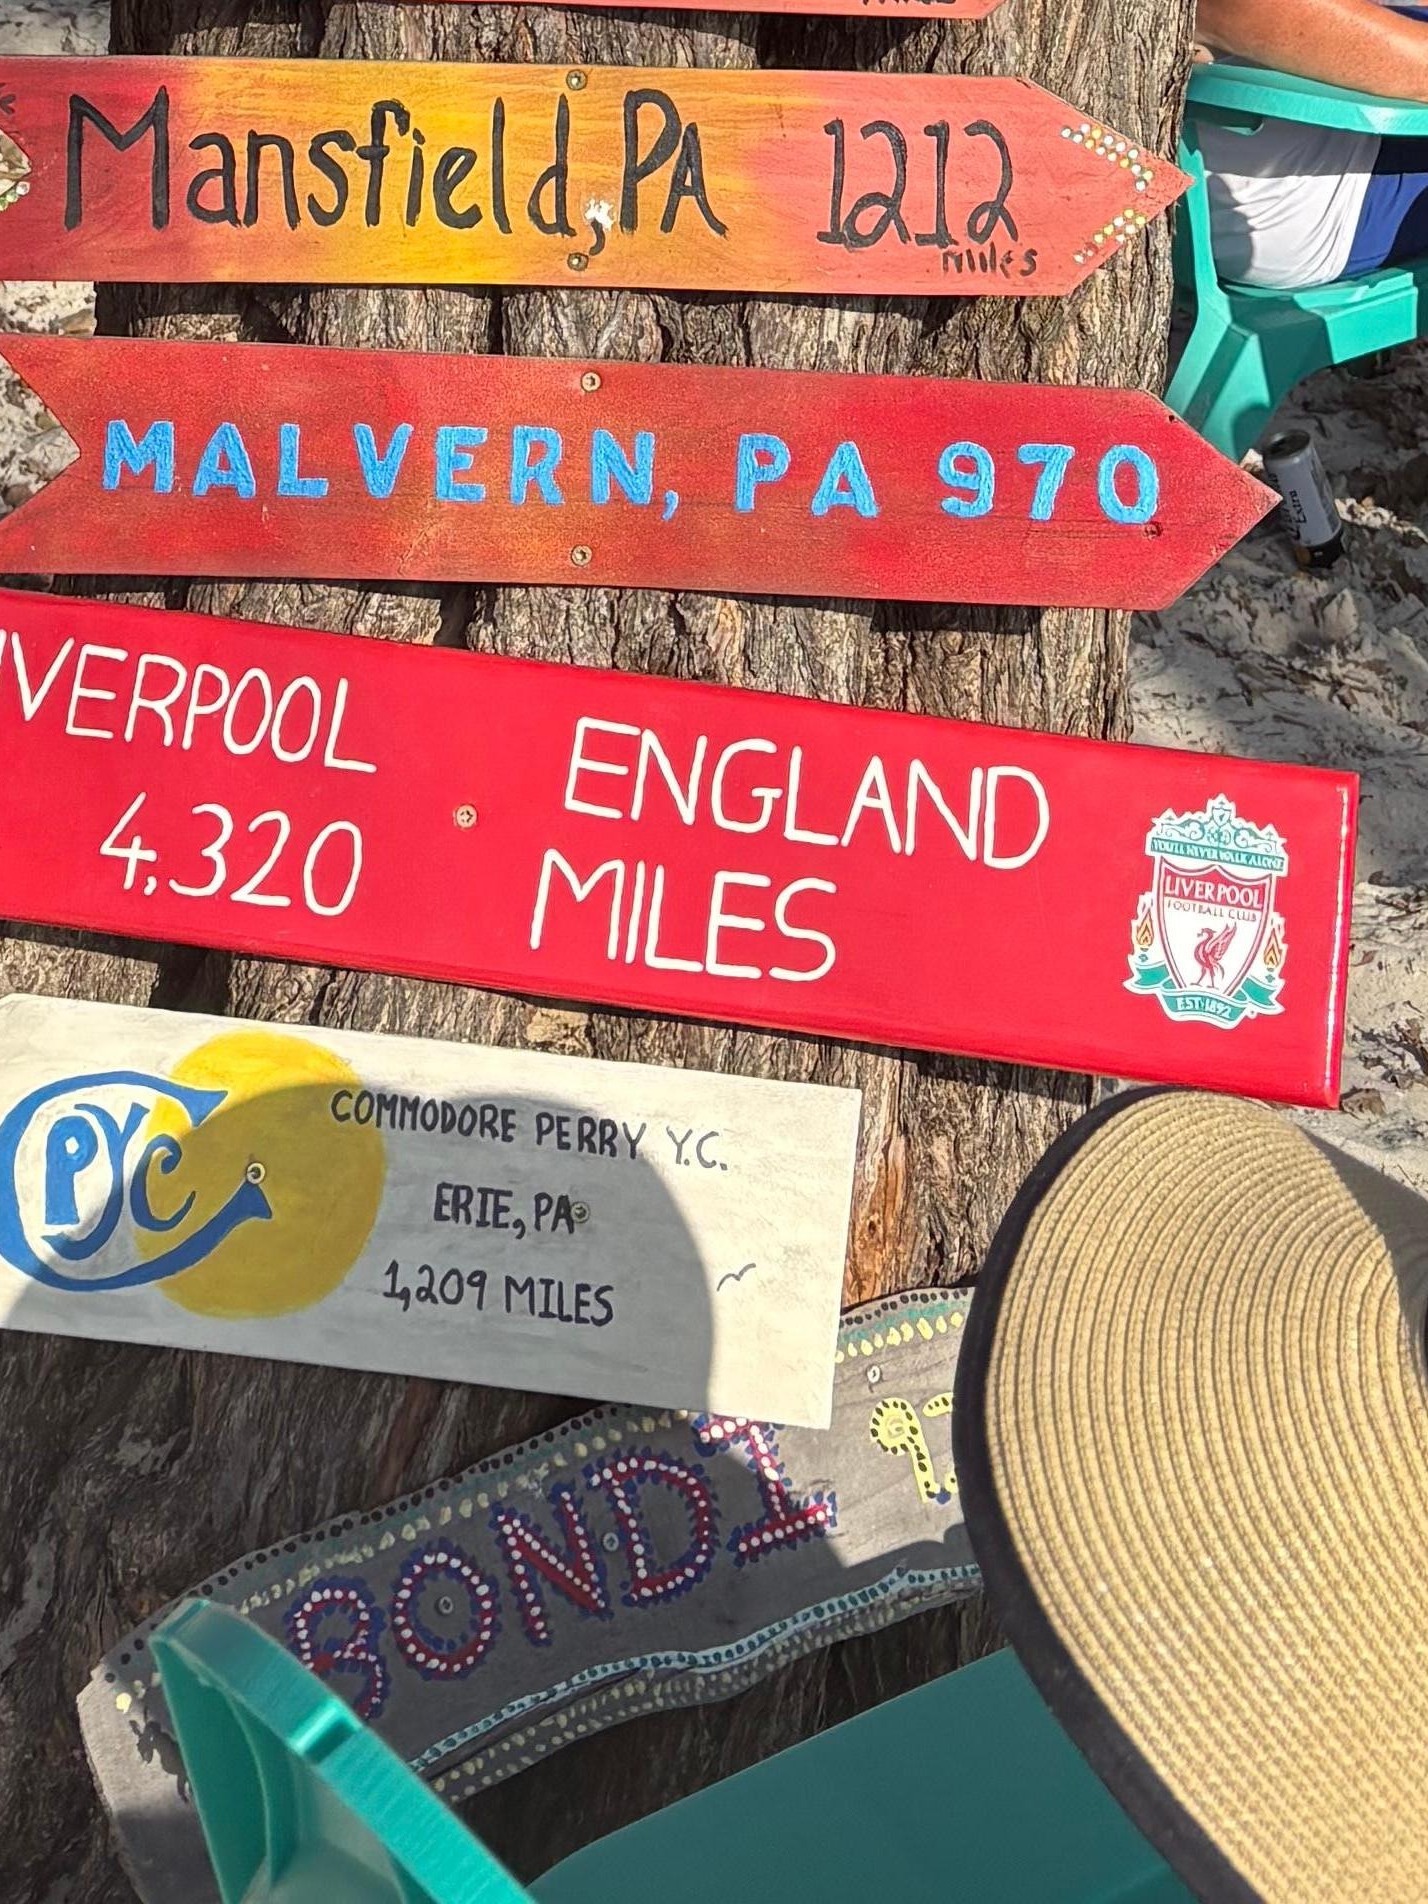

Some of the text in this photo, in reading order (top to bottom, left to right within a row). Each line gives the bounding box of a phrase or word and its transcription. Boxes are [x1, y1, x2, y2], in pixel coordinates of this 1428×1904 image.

[816, 116, 1019, 253] 1212
[941, 240, 1039, 279] miles
[100, 418, 1161, 527] MALVERN, PA 970
[563, 715, 1051, 870] ENGLAND
[98, 791, 838, 983] 4,320 MILES
[1164, 875, 1264, 910] LIVERPOOL
[1167, 899, 1257, 922] FOOTBALL CLUB
[330, 1089, 729, 1171] COMMODORE PERRY Y.C.
[433, 1180, 526, 1241] ERIE,
[382, 1258, 615, 1327] 1,209 MILES
